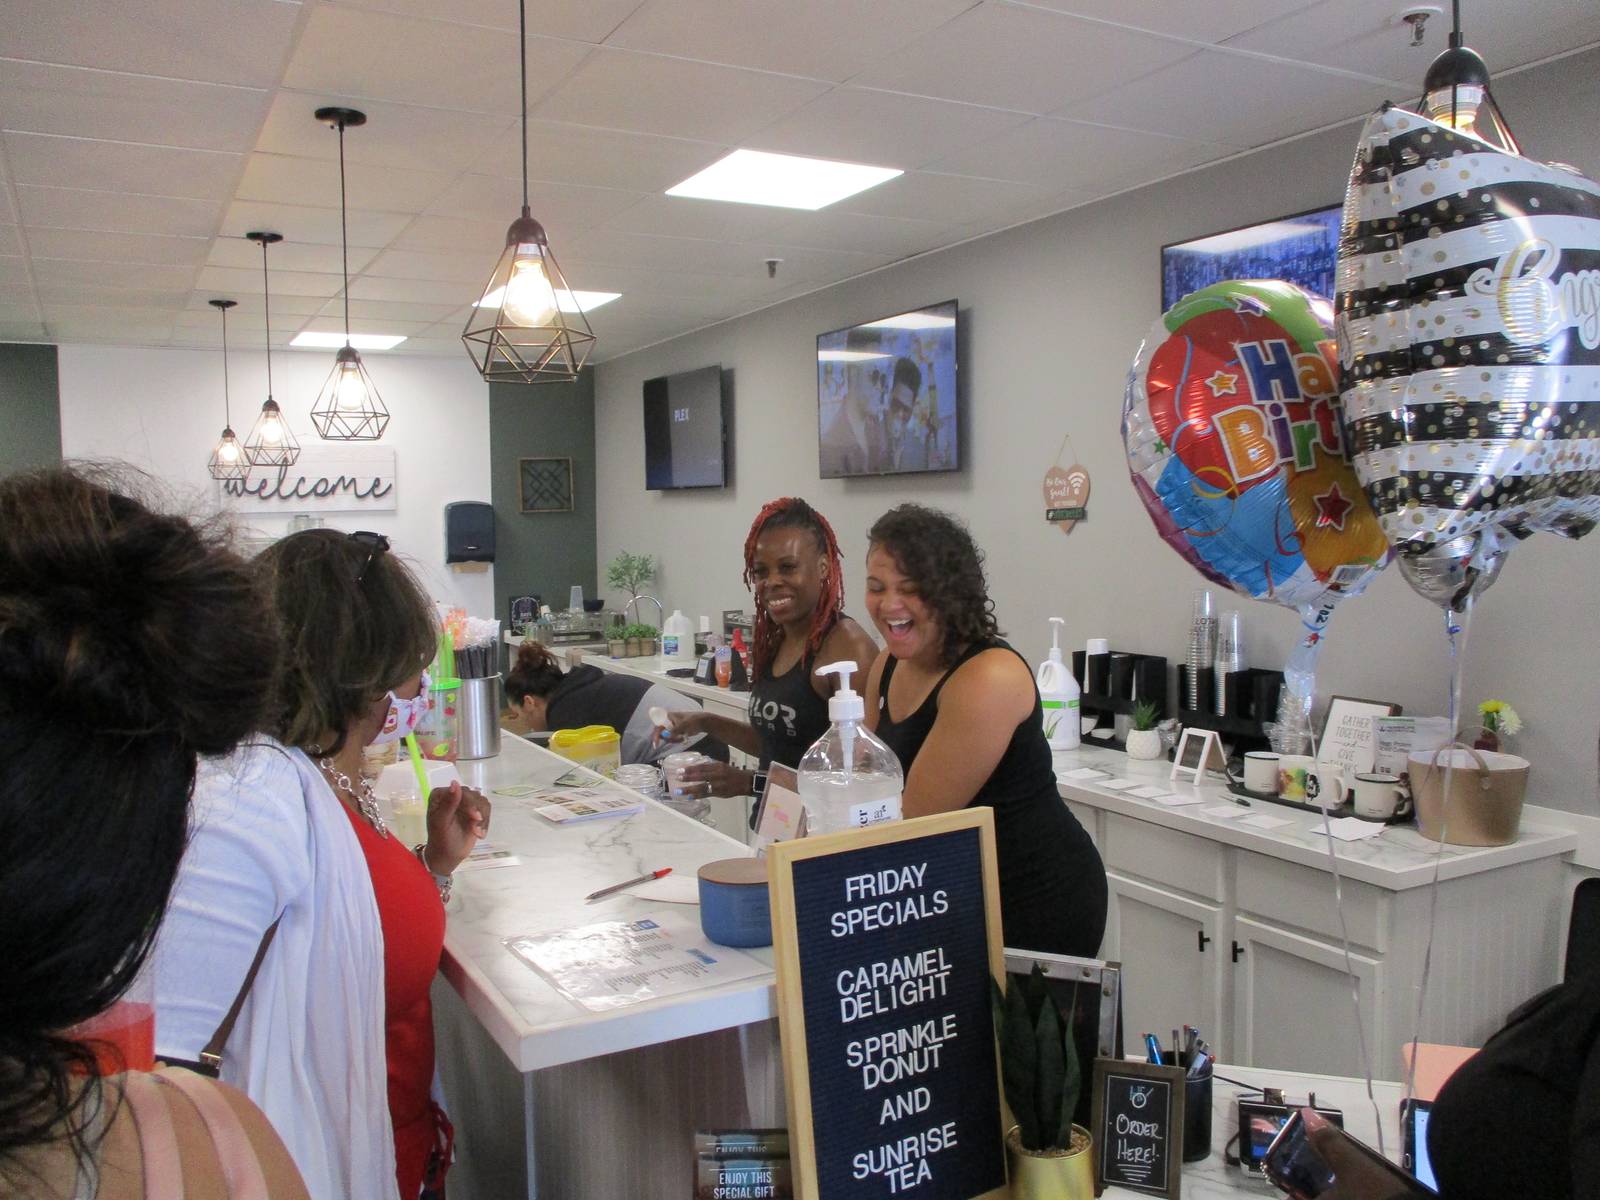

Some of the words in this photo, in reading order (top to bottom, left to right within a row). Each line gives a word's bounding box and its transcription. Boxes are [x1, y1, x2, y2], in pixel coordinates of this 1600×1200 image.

[1211, 401, 1354, 483] Birt
[223, 456, 393, 501] welcome
[1335, 726, 1372, 741] TOGETHER
[1341, 715, 1370, 728] GATHER
[845, 862, 928, 902] FRIDAY
[830, 890, 949, 938] SPECIALS
[836, 947, 953, 996] CARAMEL
[840, 971, 951, 1023] DELIGHT
[846, 1014, 958, 1067] SPRINKLE
[862, 1043, 944, 1090] DONUT
[879, 1087, 931, 1126] AND
[852, 1121, 958, 1179] SUNRISE
[713, 1187, 752, 1199] SPECIAL
[754, 1186, 775, 1198] GIFT
[719, 1172, 748, 1185] ENJOY
[750, 1171, 772, 1184] THIS
[884, 1158, 933, 1194] TEA
